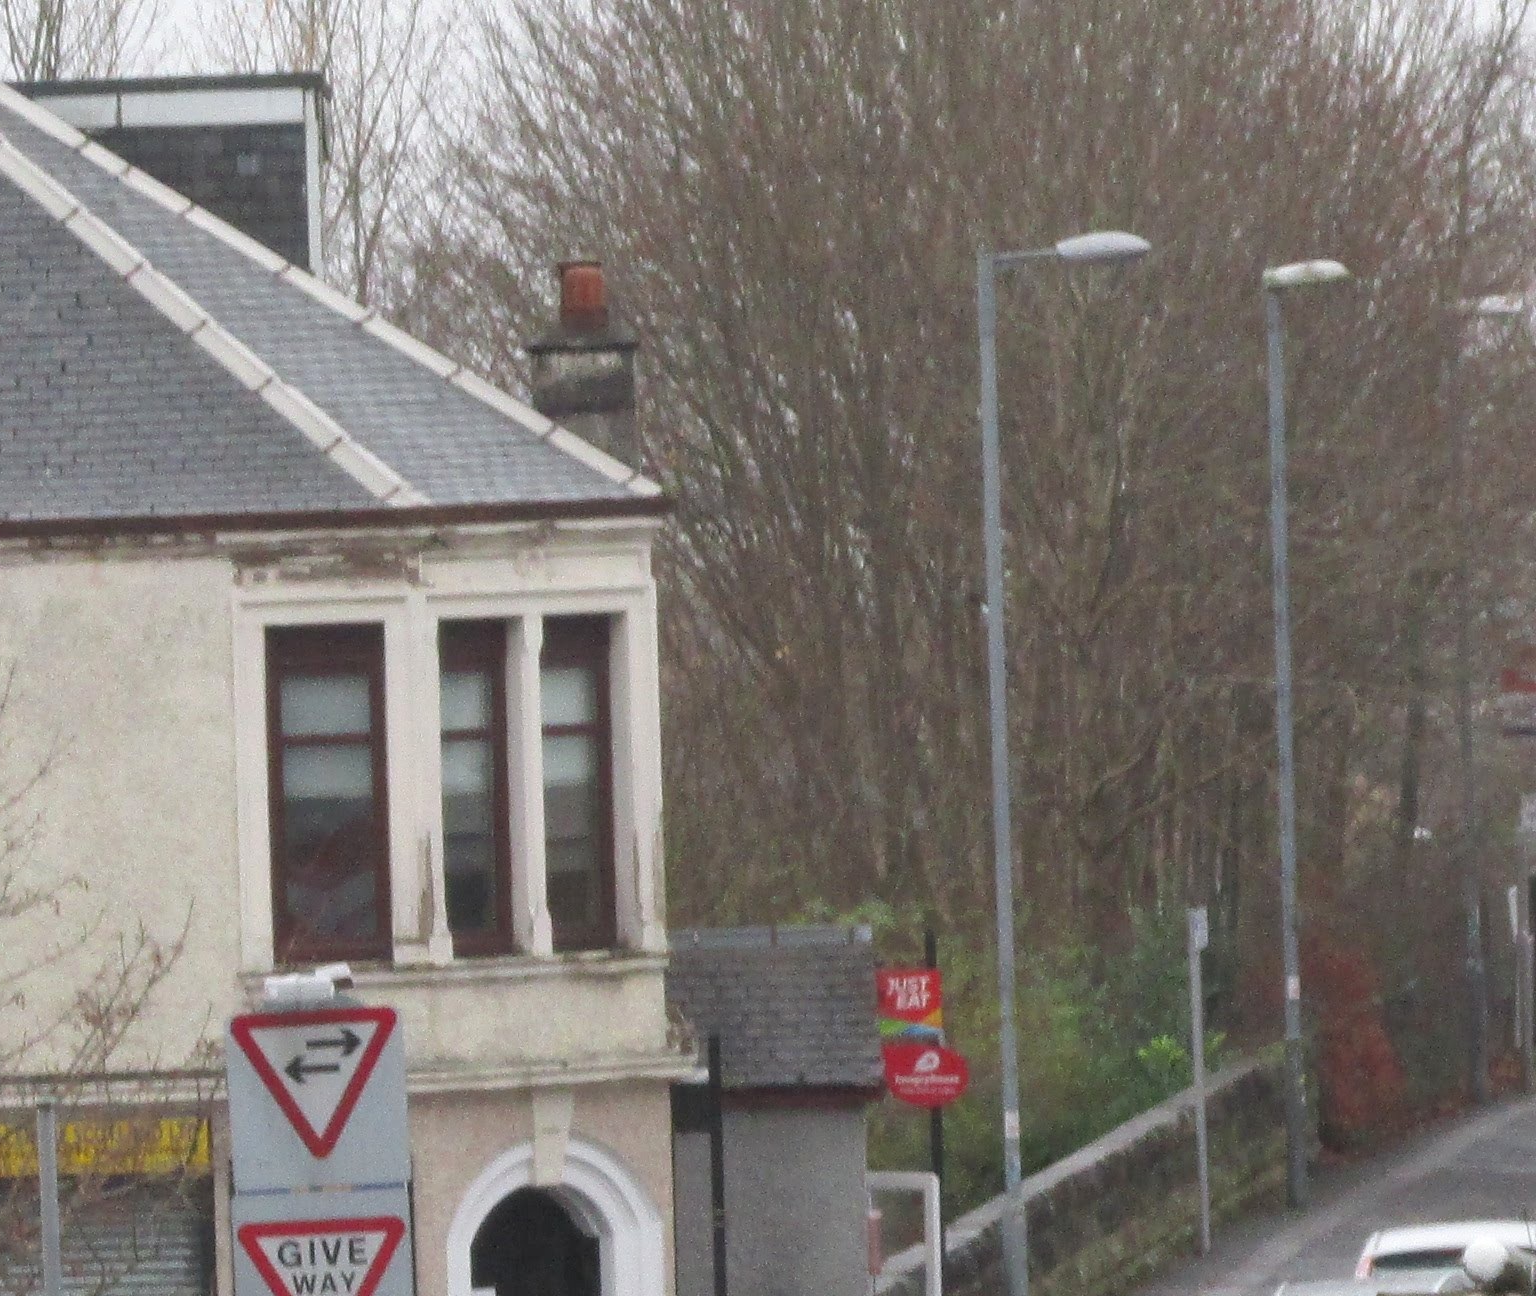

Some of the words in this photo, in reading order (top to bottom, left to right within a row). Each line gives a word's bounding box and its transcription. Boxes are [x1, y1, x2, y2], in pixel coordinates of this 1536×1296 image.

[886, 975, 930, 995] JUST
[896, 991, 931, 1010] EAT
[278, 1237, 369, 1268] GIVE
[293, 1270, 357, 1296] WAY
